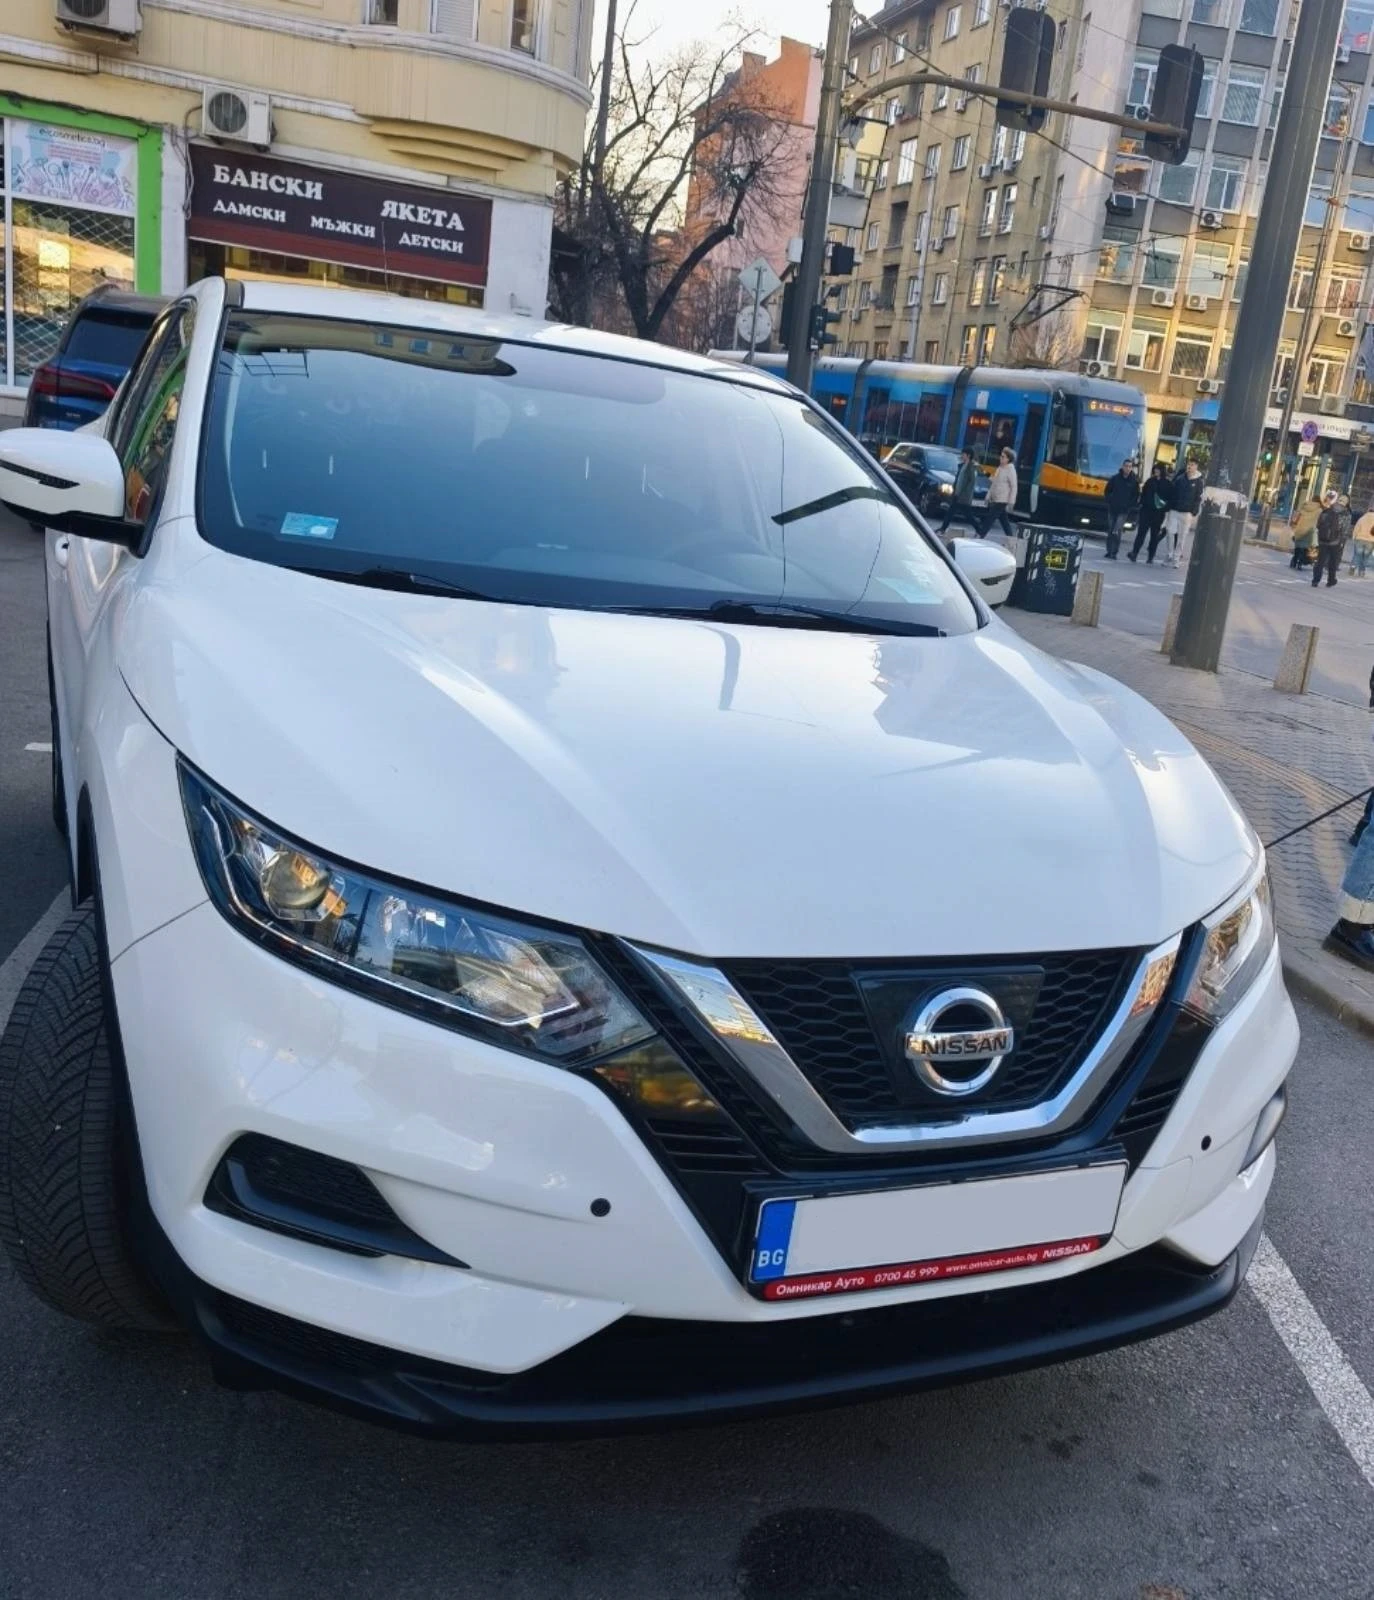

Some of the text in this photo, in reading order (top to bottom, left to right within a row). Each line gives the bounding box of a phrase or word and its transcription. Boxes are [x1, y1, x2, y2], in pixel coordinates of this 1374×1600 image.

[213, 164, 464, 231] БАНСКИ ЯКЕТА
[213, 199, 464, 254] ДАМСКИ МЪЖКИ ДЕТСКИ
[921, 1035, 1008, 1055] NISSAN
[758, 1249, 784, 1267] BG
[776, 1242, 1092, 1295] Омникар Ауто 0700 45 999 www.omnicar-auto.bg NISSAN
